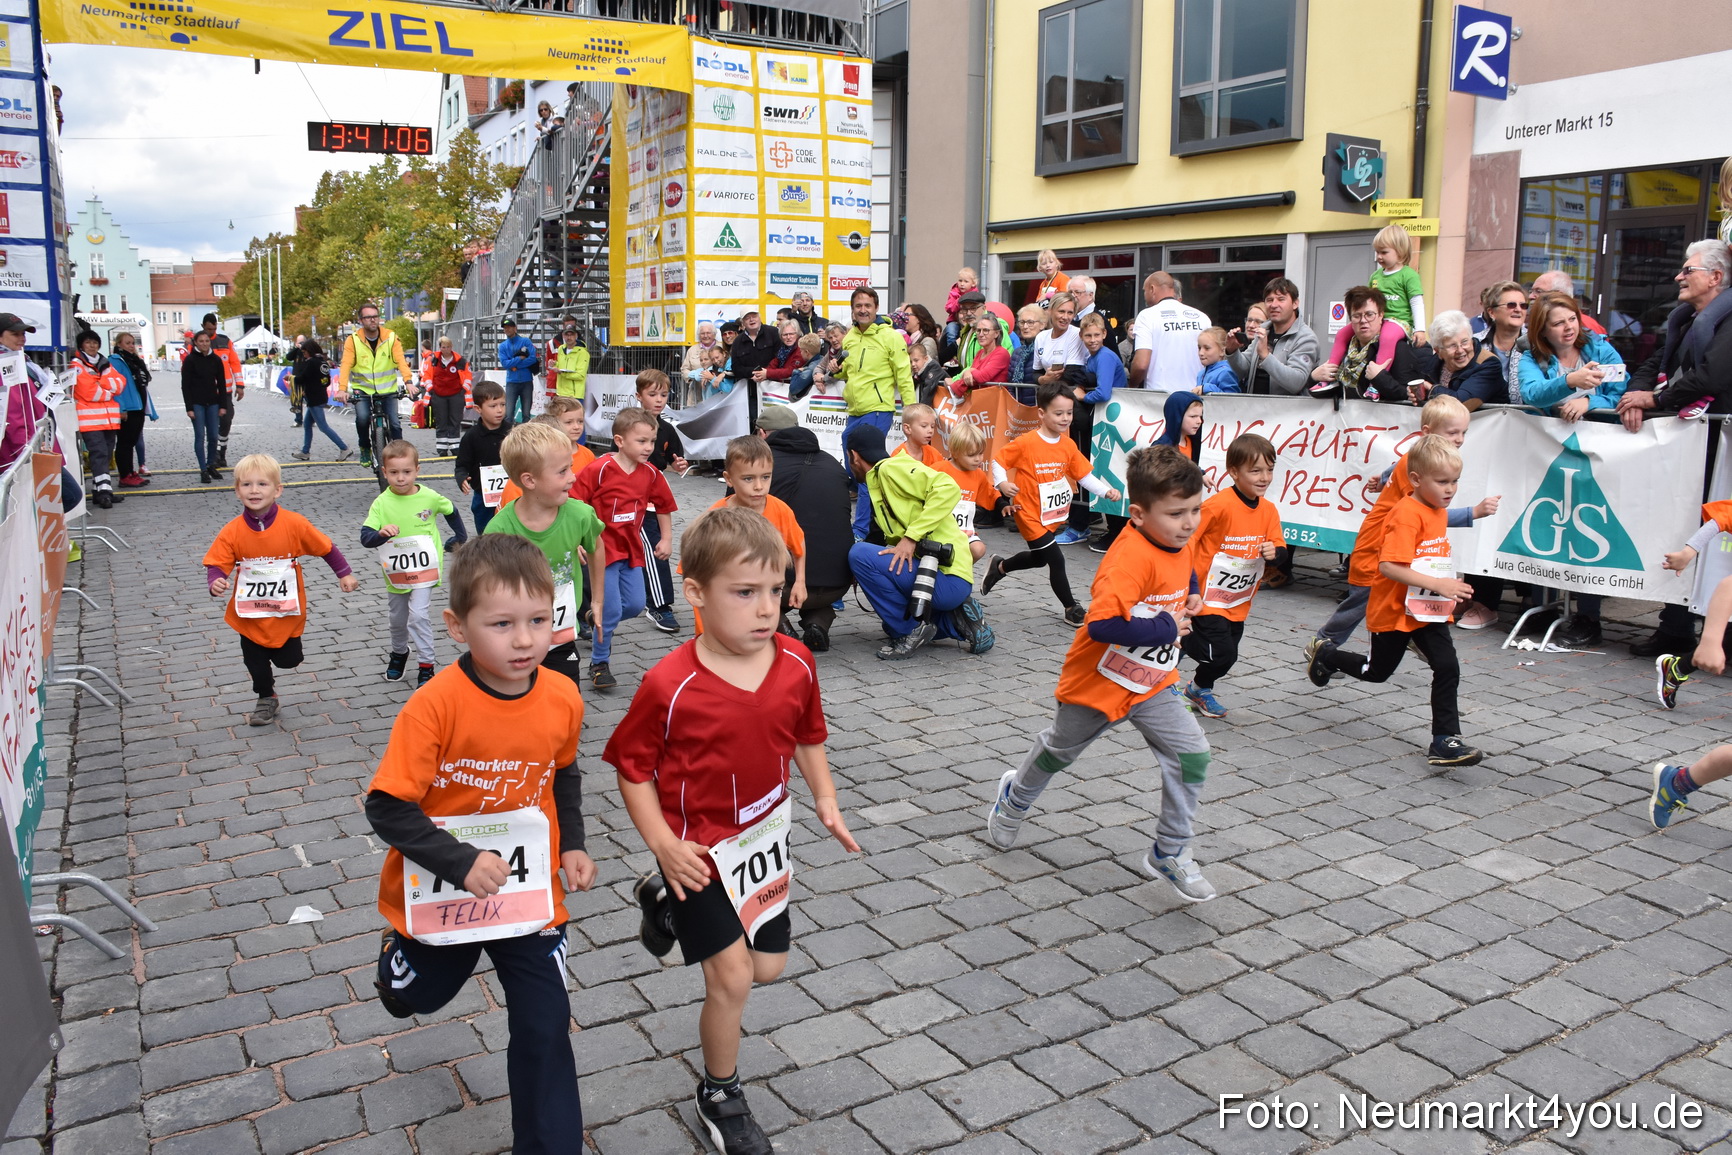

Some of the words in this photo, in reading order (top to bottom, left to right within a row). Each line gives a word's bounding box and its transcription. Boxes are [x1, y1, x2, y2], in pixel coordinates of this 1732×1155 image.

[80, 4, 170, 26] Neumarkter
[174, 14, 240, 30] Stadtlauf
[327, 9, 474, 56] ZIEL
[548, 48, 613, 64] Neumarkter
[616, 56, 666, 66] Stadtlauf
[724, 72, 750, 80] energie
[764, 106, 799, 119] swn
[1505, 122, 1552, 140] Unterer
[1555, 115, 1592, 133] Markt
[1598, 111, 1614, 127] 15
[696, 148, 738, 158] RAIL.ONE
[795, 148, 814, 156] CODE
[795, 156, 817, 164] CLINIC
[713, 190, 756, 200] VARIOTEC
[0, 278, 31, 288] sbräu
[772, 275, 798, 283] Neumarkter
[1164, 322, 1203, 332] STAFFEL
[1047, 490, 1071, 508] 7055
[1283, 528, 1298, 540] 63
[1300, 530, 1317, 543] 52
[389, 551, 430, 571] 7010
[1217, 570, 1257, 590] 7254
[1494, 558, 1514, 572] Jura
[1518, 561, 1561, 580] Gebäude
[1564, 570, 1605, 588] Service
[1609, 575, 1644, 590] GmbH
[246, 580, 288, 597] 7074
[1144, 588, 1185, 602] Neumarkter
[1425, 604, 1443, 612] MAXI
[461, 823, 508, 837] BOCK
[756, 880, 788, 905] Tobias
[436, 901, 504, 926] FELIX
